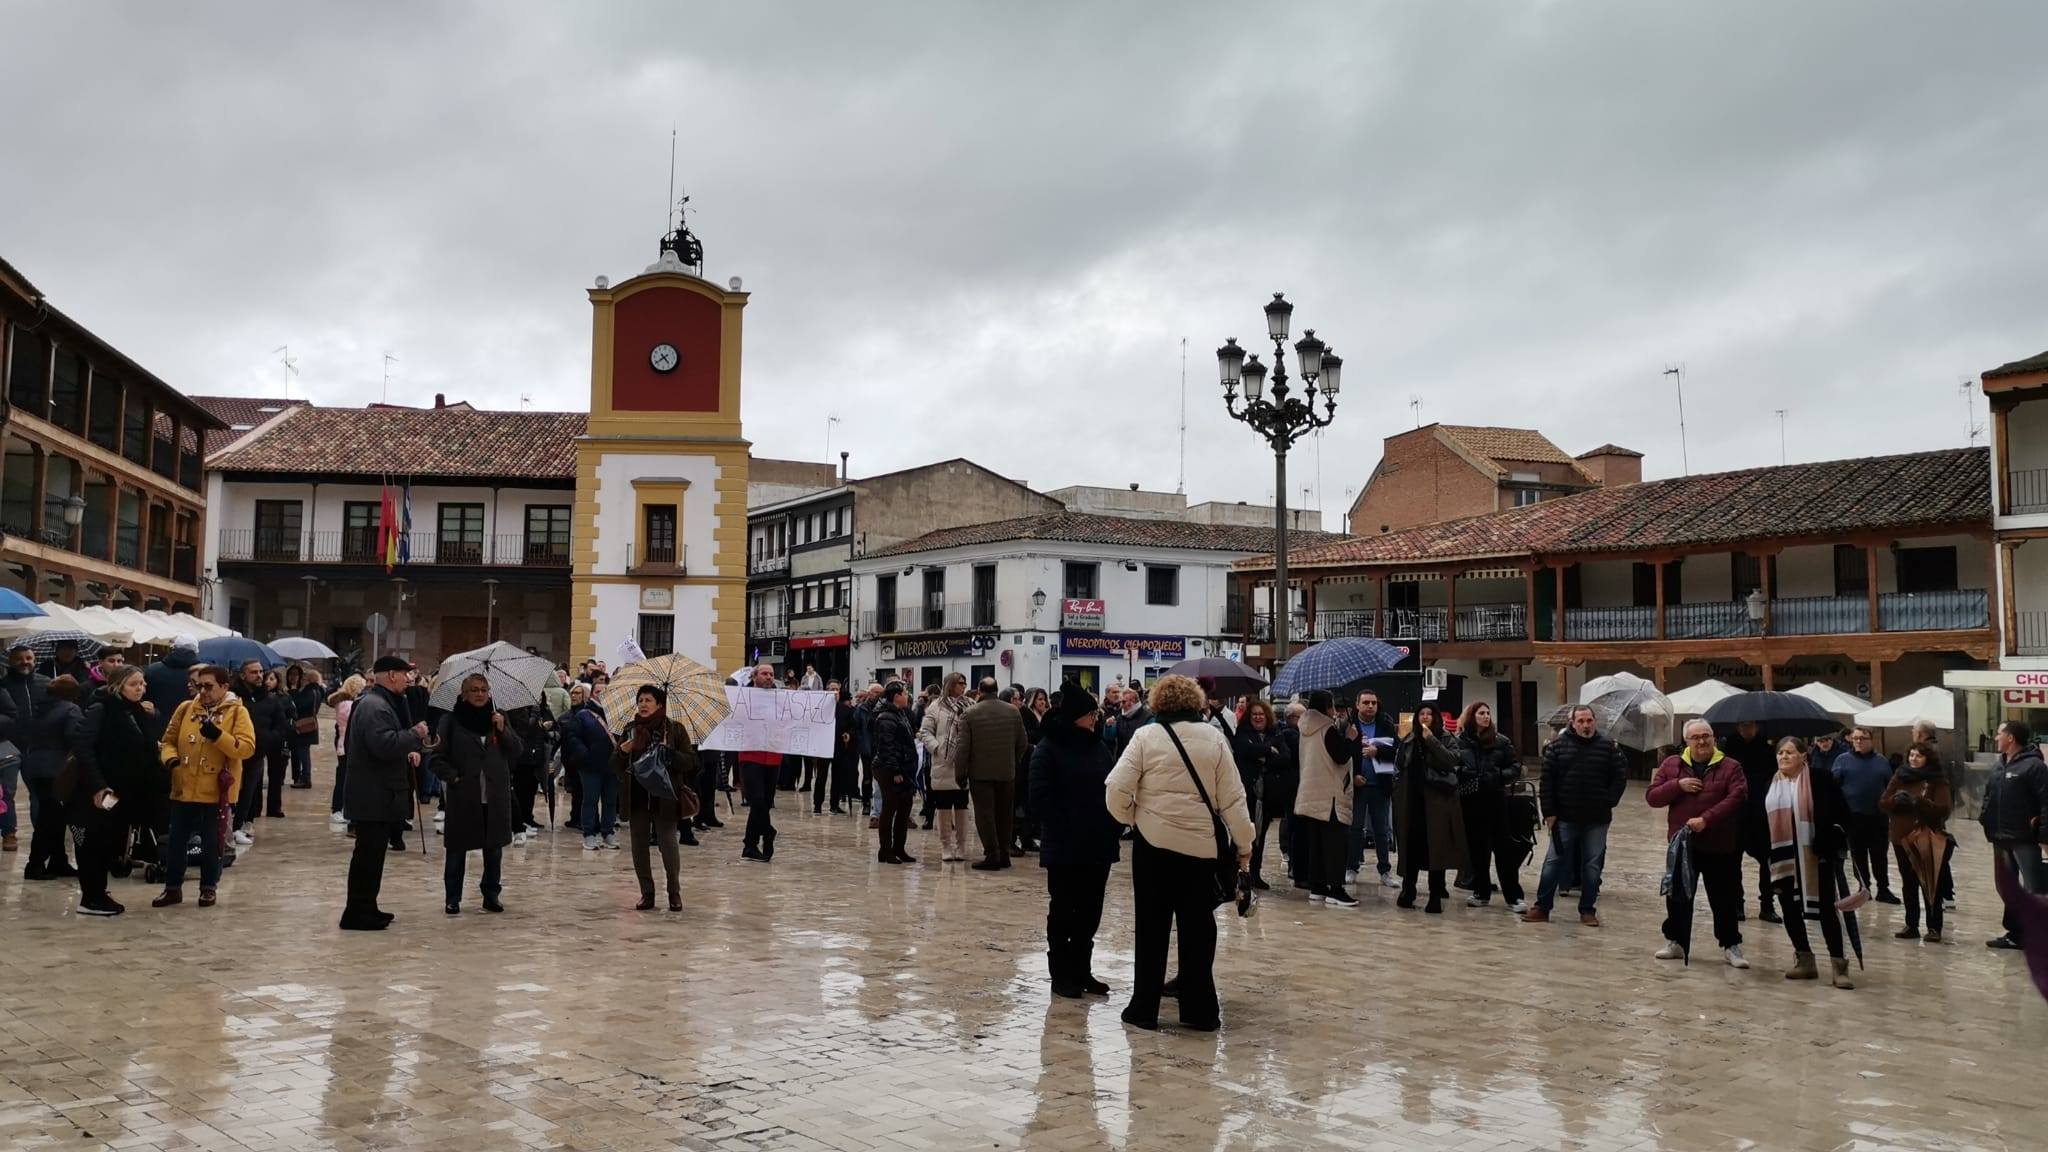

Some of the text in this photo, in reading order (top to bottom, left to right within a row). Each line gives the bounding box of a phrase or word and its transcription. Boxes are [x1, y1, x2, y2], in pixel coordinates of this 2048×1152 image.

[897, 640, 949, 656] INTEROPTICOS
[1067, 638, 1182, 651] INTEROPTICOS CIEMPOZUELOS
[731, 687, 765, 720] AL
